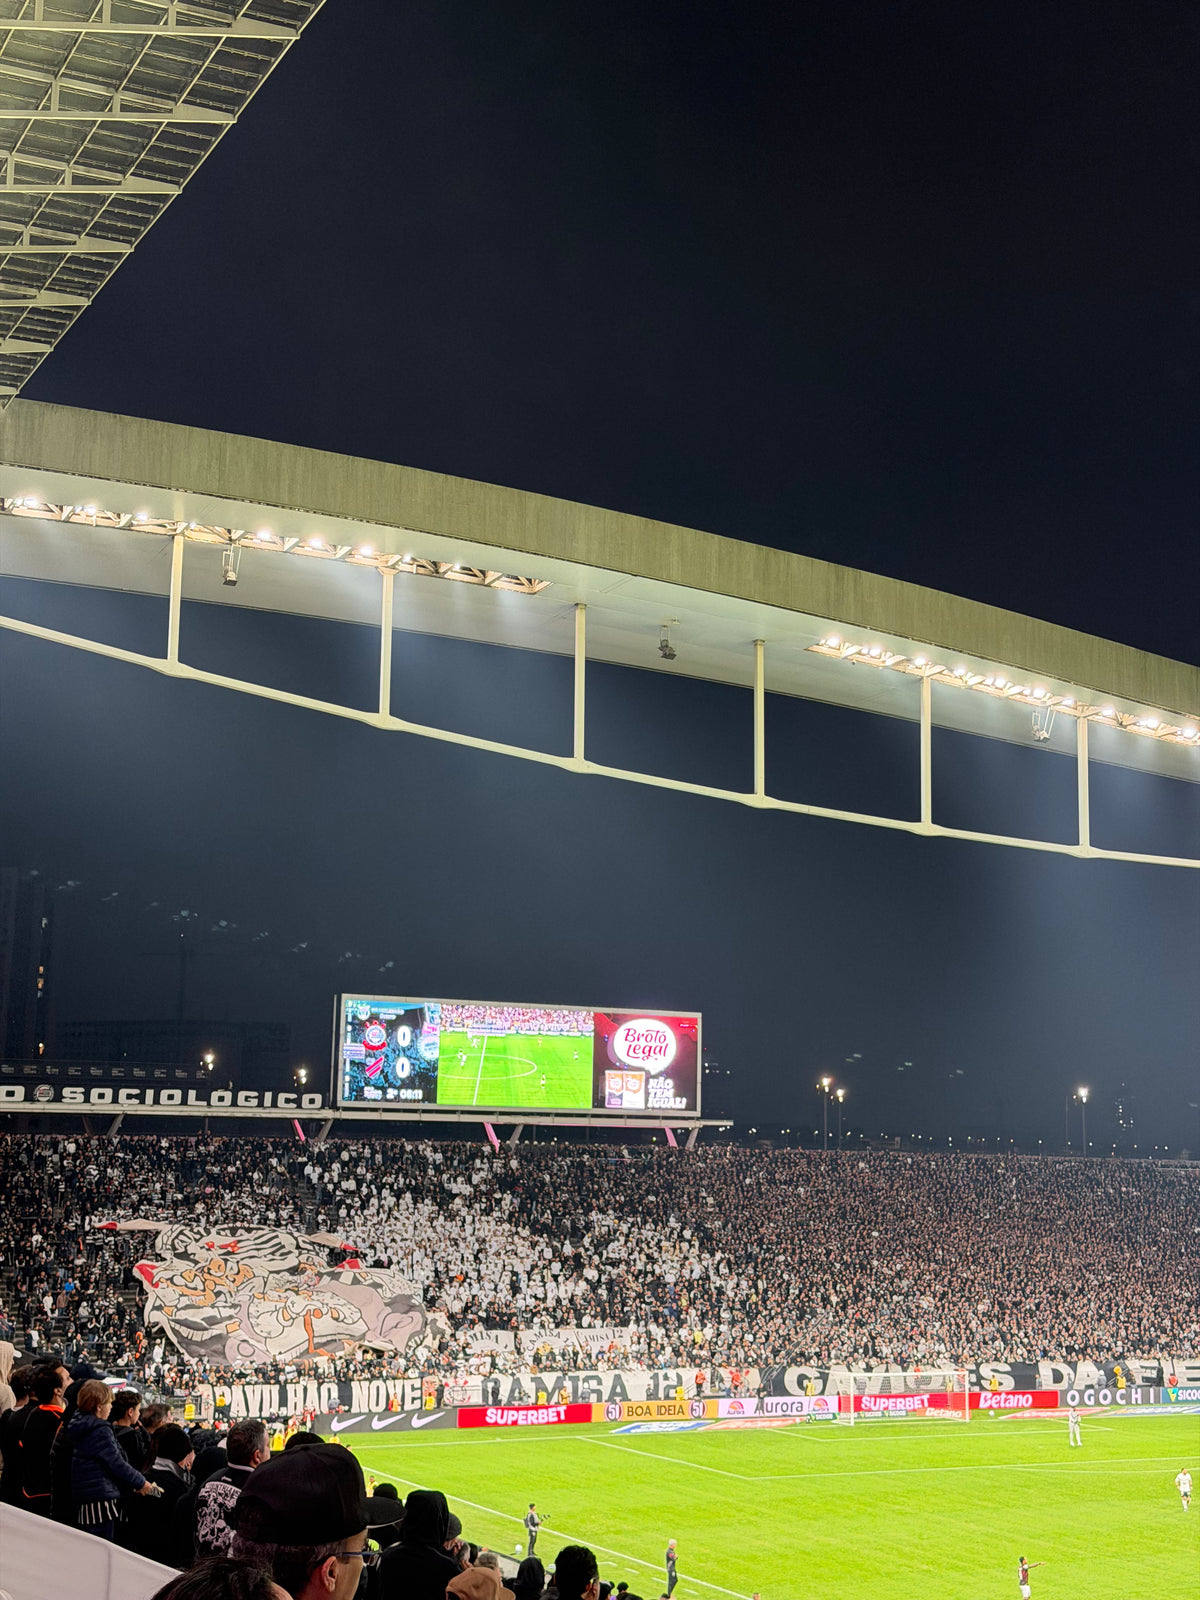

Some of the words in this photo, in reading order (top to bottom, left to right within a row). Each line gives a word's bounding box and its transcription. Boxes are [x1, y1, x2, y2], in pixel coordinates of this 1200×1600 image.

[397, 1025, 411, 1047] 0
[624, 1028, 667, 1044] Broto
[626, 1043, 669, 1061] Legal
[396, 1056, 410, 1079] 0
[647, 1076, 674, 1089] NÃO
[61, 1087, 323, 1109] SOCIOLÓGICO
[648, 1088, 675, 1098] TEM
[647, 1096, 687, 1109] IGUAL!
[351, 1378, 421, 1413] NOVE
[861, 1394, 930, 1411] SUPERBET
[978, 1390, 1033, 1409] Betano
[1066, 1388, 1155, 1406] OGOCHI
[485, 1405, 567, 1426] SUPERBET
[607, 1403, 620, 1420] 51
[626, 1406, 652, 1417] BOA
[656, 1404, 685, 1416] IDEIA
[690, 1401, 704, 1418] 51
[925, 1407, 962, 1418] Betano
